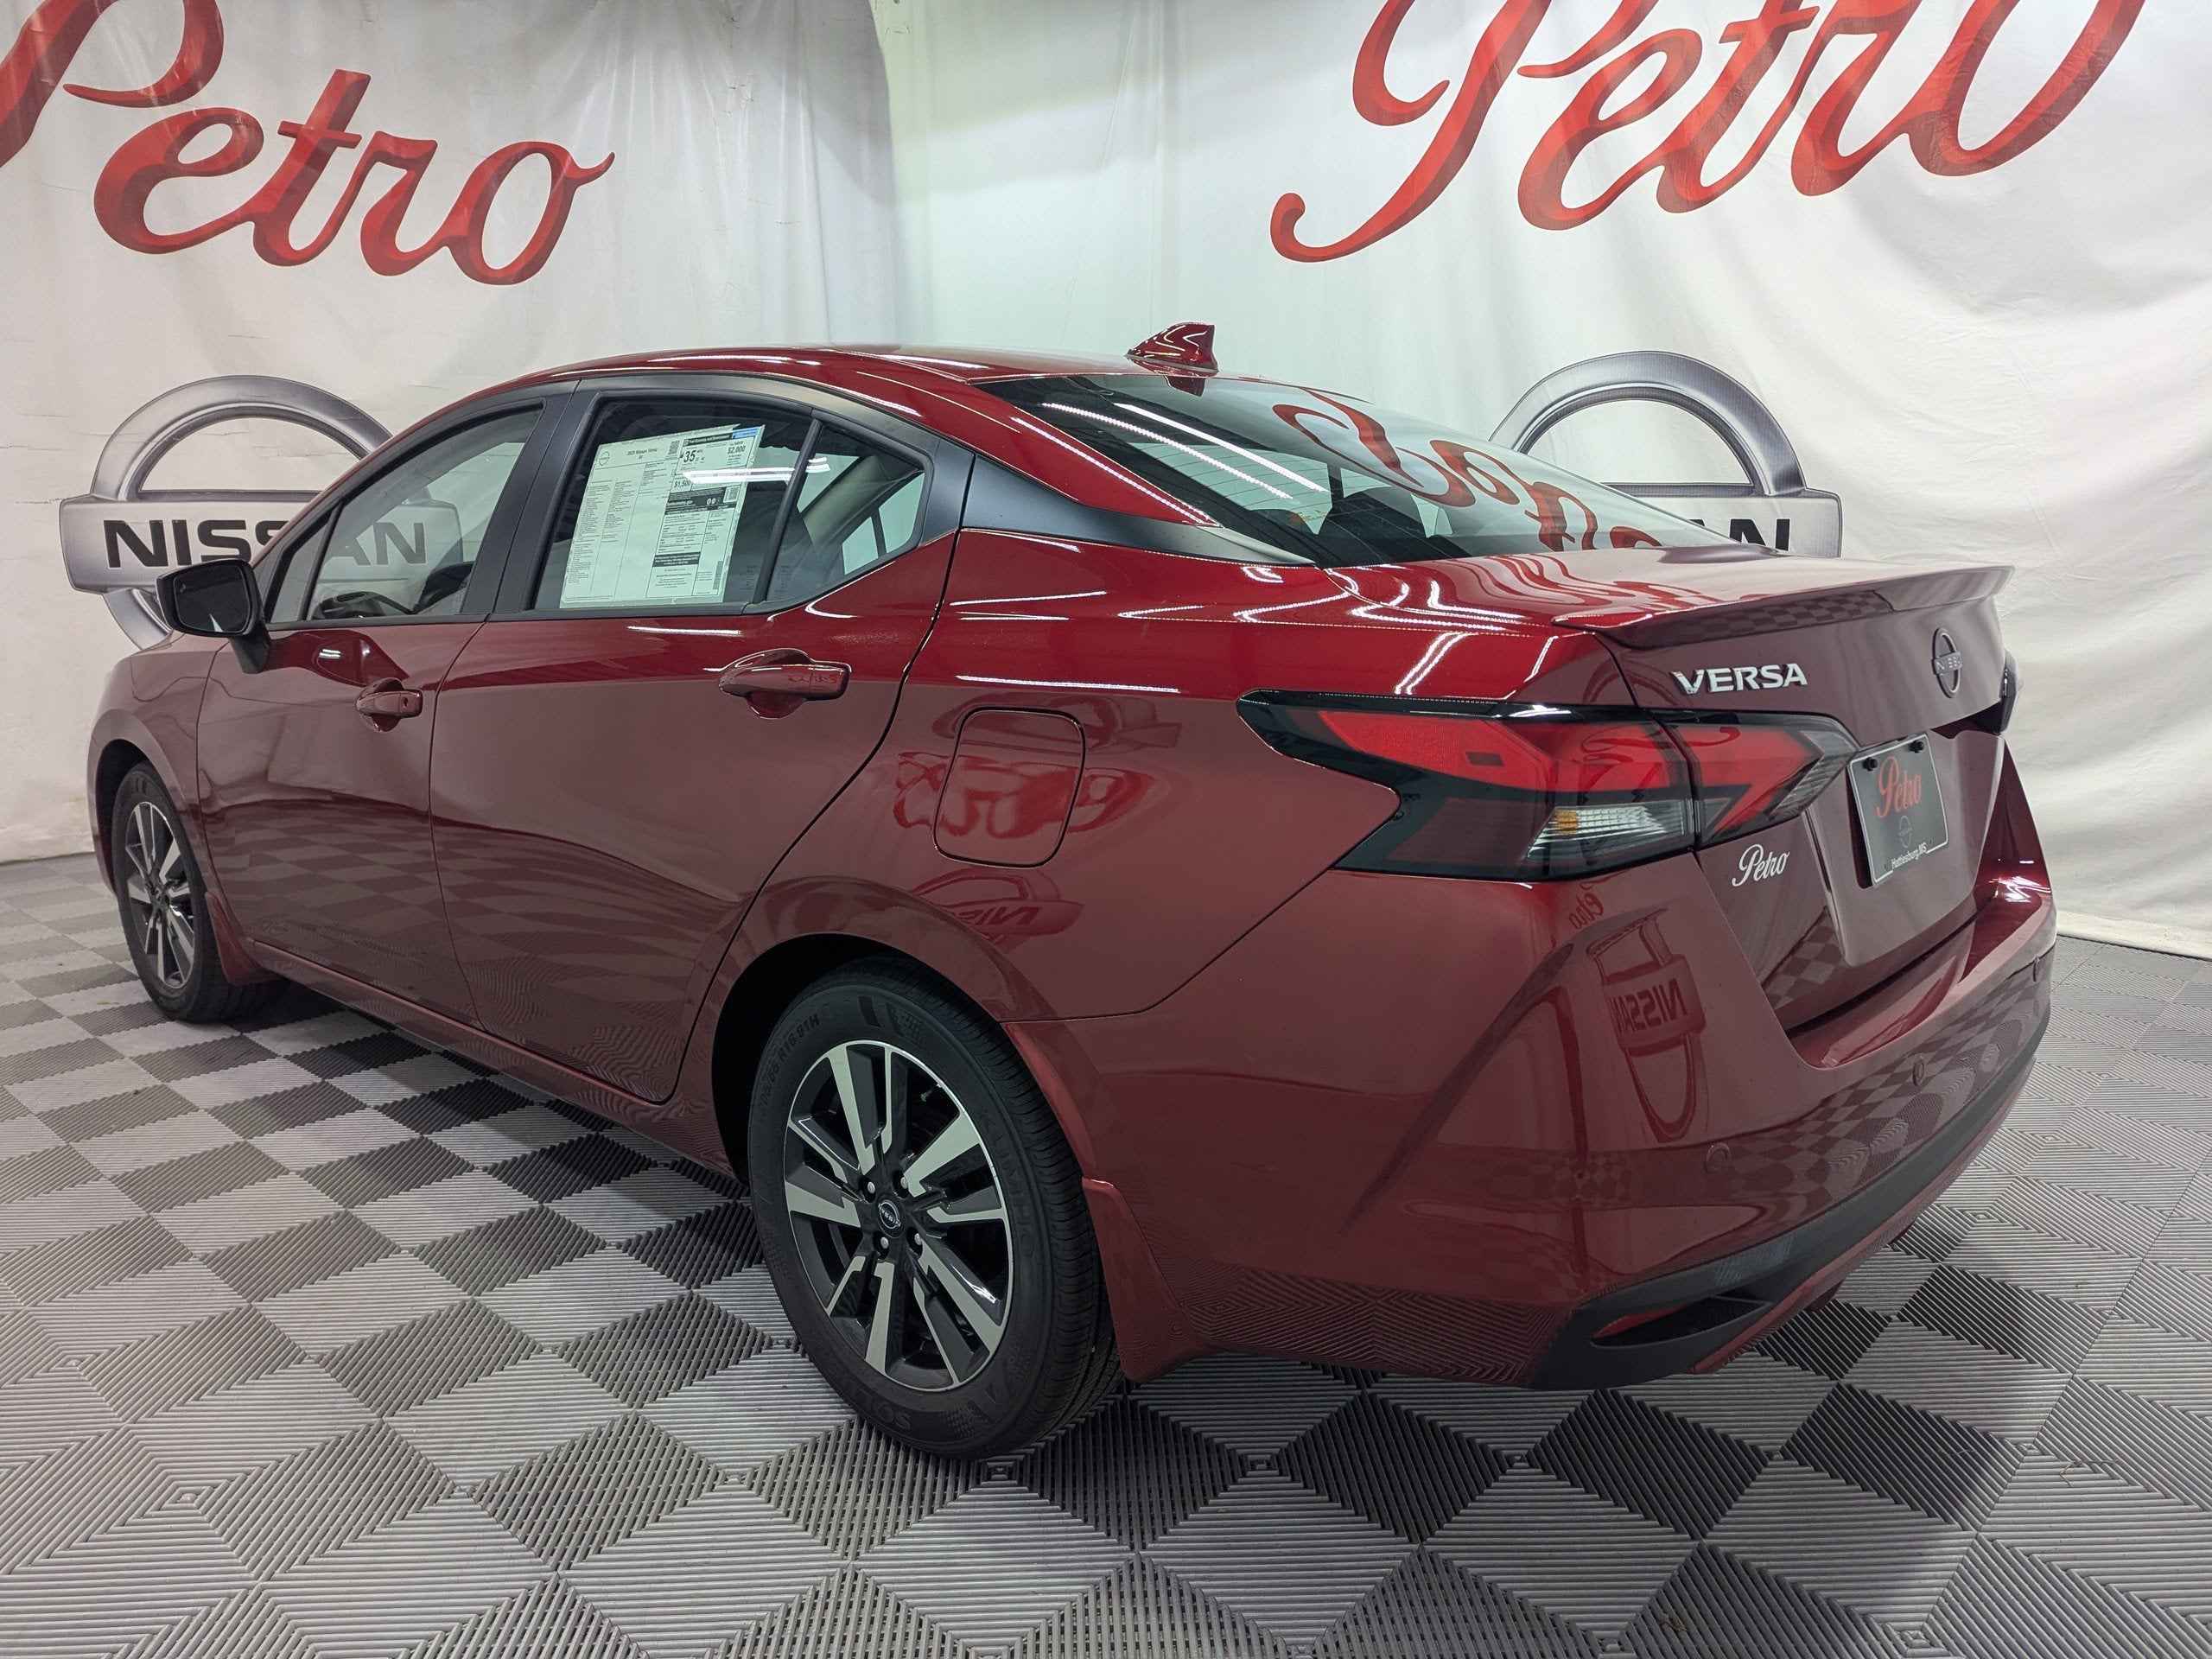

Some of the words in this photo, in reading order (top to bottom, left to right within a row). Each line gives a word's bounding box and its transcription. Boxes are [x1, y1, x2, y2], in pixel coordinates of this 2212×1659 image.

[683, 450, 696, 463] 35
[1672, 662, 1808, 695] VERSA
[1876, 755, 1923, 819] Petro
[1731, 843, 1791, 887] Petro
